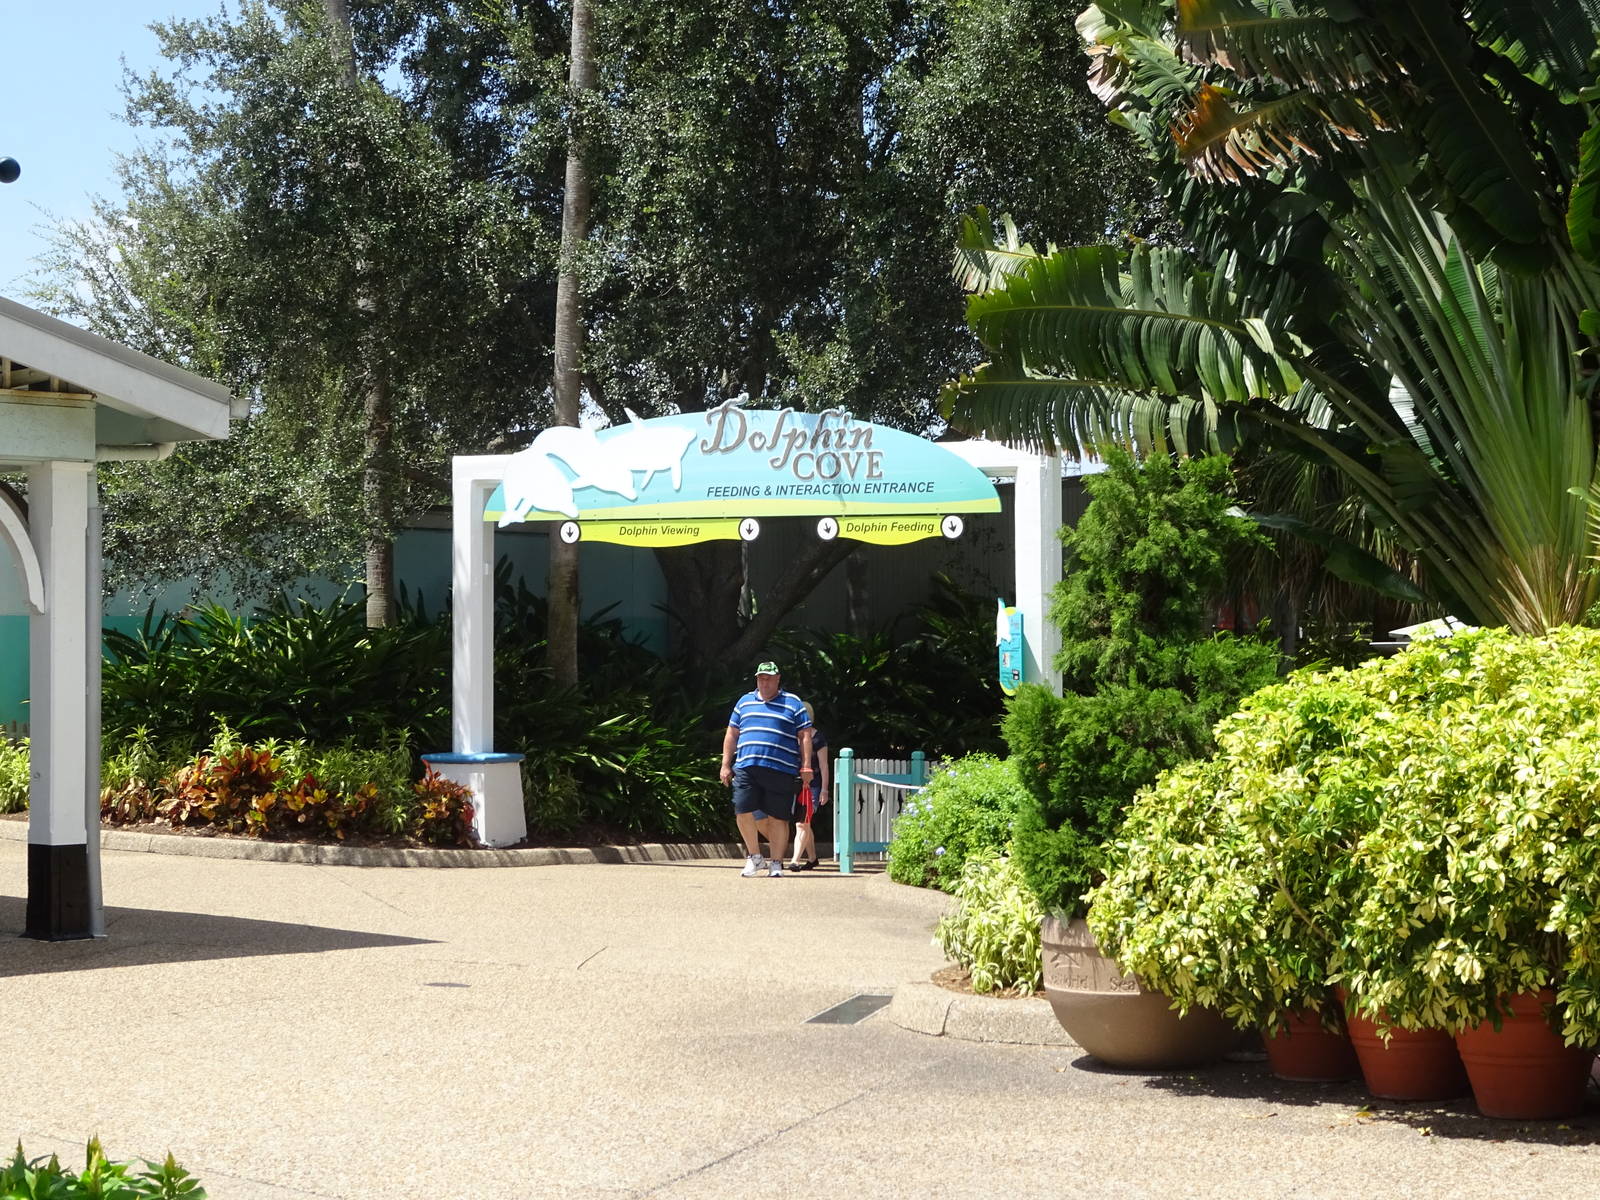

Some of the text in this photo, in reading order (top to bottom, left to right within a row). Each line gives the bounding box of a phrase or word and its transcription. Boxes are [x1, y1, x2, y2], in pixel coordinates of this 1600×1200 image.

[700, 393, 874, 470] Dolphin
[792, 451, 884, 481] COVE
[706, 481, 935, 498] FEEDING & INTERACTION ENTRANCE
[619, 525, 700, 538] Dolphin Viewing
[846, 521, 935, 534] Dolphin Feeding
